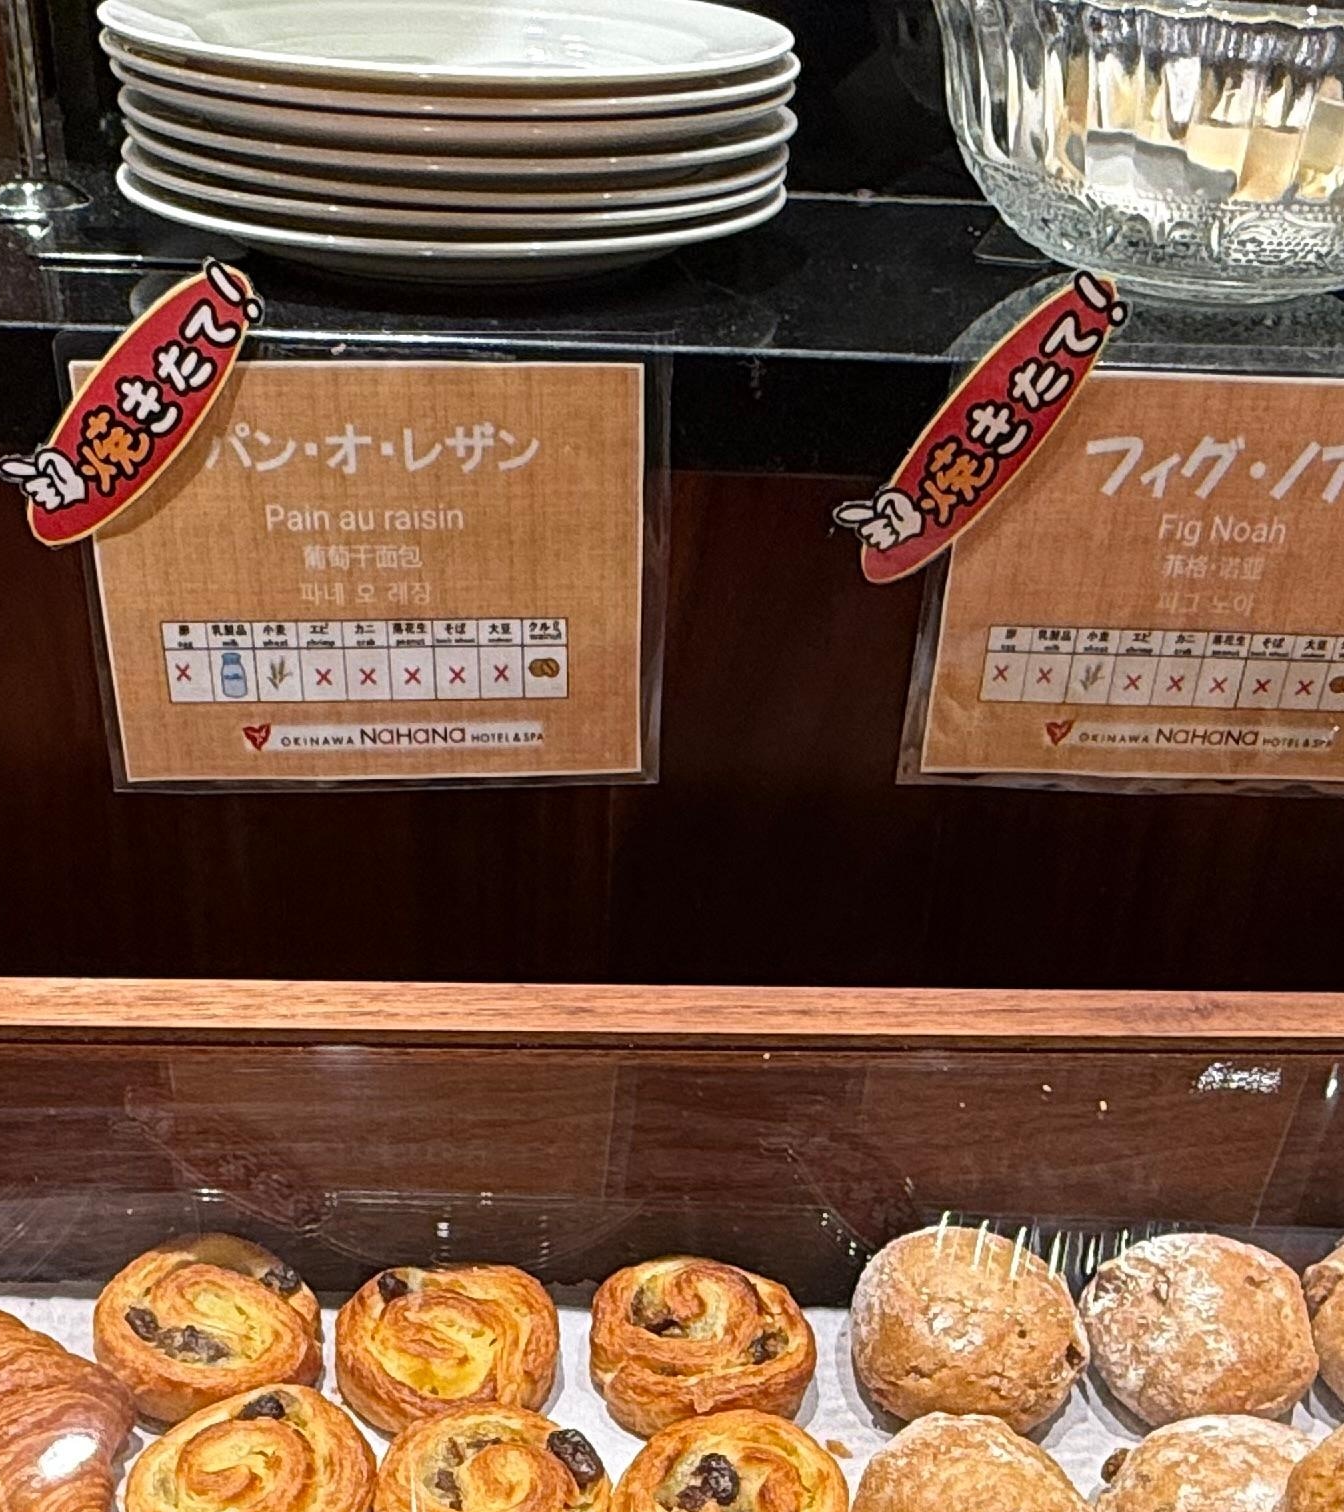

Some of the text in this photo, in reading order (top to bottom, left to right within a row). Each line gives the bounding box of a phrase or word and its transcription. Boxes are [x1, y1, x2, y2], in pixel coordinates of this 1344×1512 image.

[265, 504, 464, 531] Pain au raisin
[1159, 515, 1286, 546] Fig Noah
[355, 583, 378, 604] 오
[280, 735, 355, 747] OKINAWA
[471, 733, 509, 743] HOTEL
[523, 732, 544, 742] SPA
[1079, 732, 1149, 744] OKINAWA
